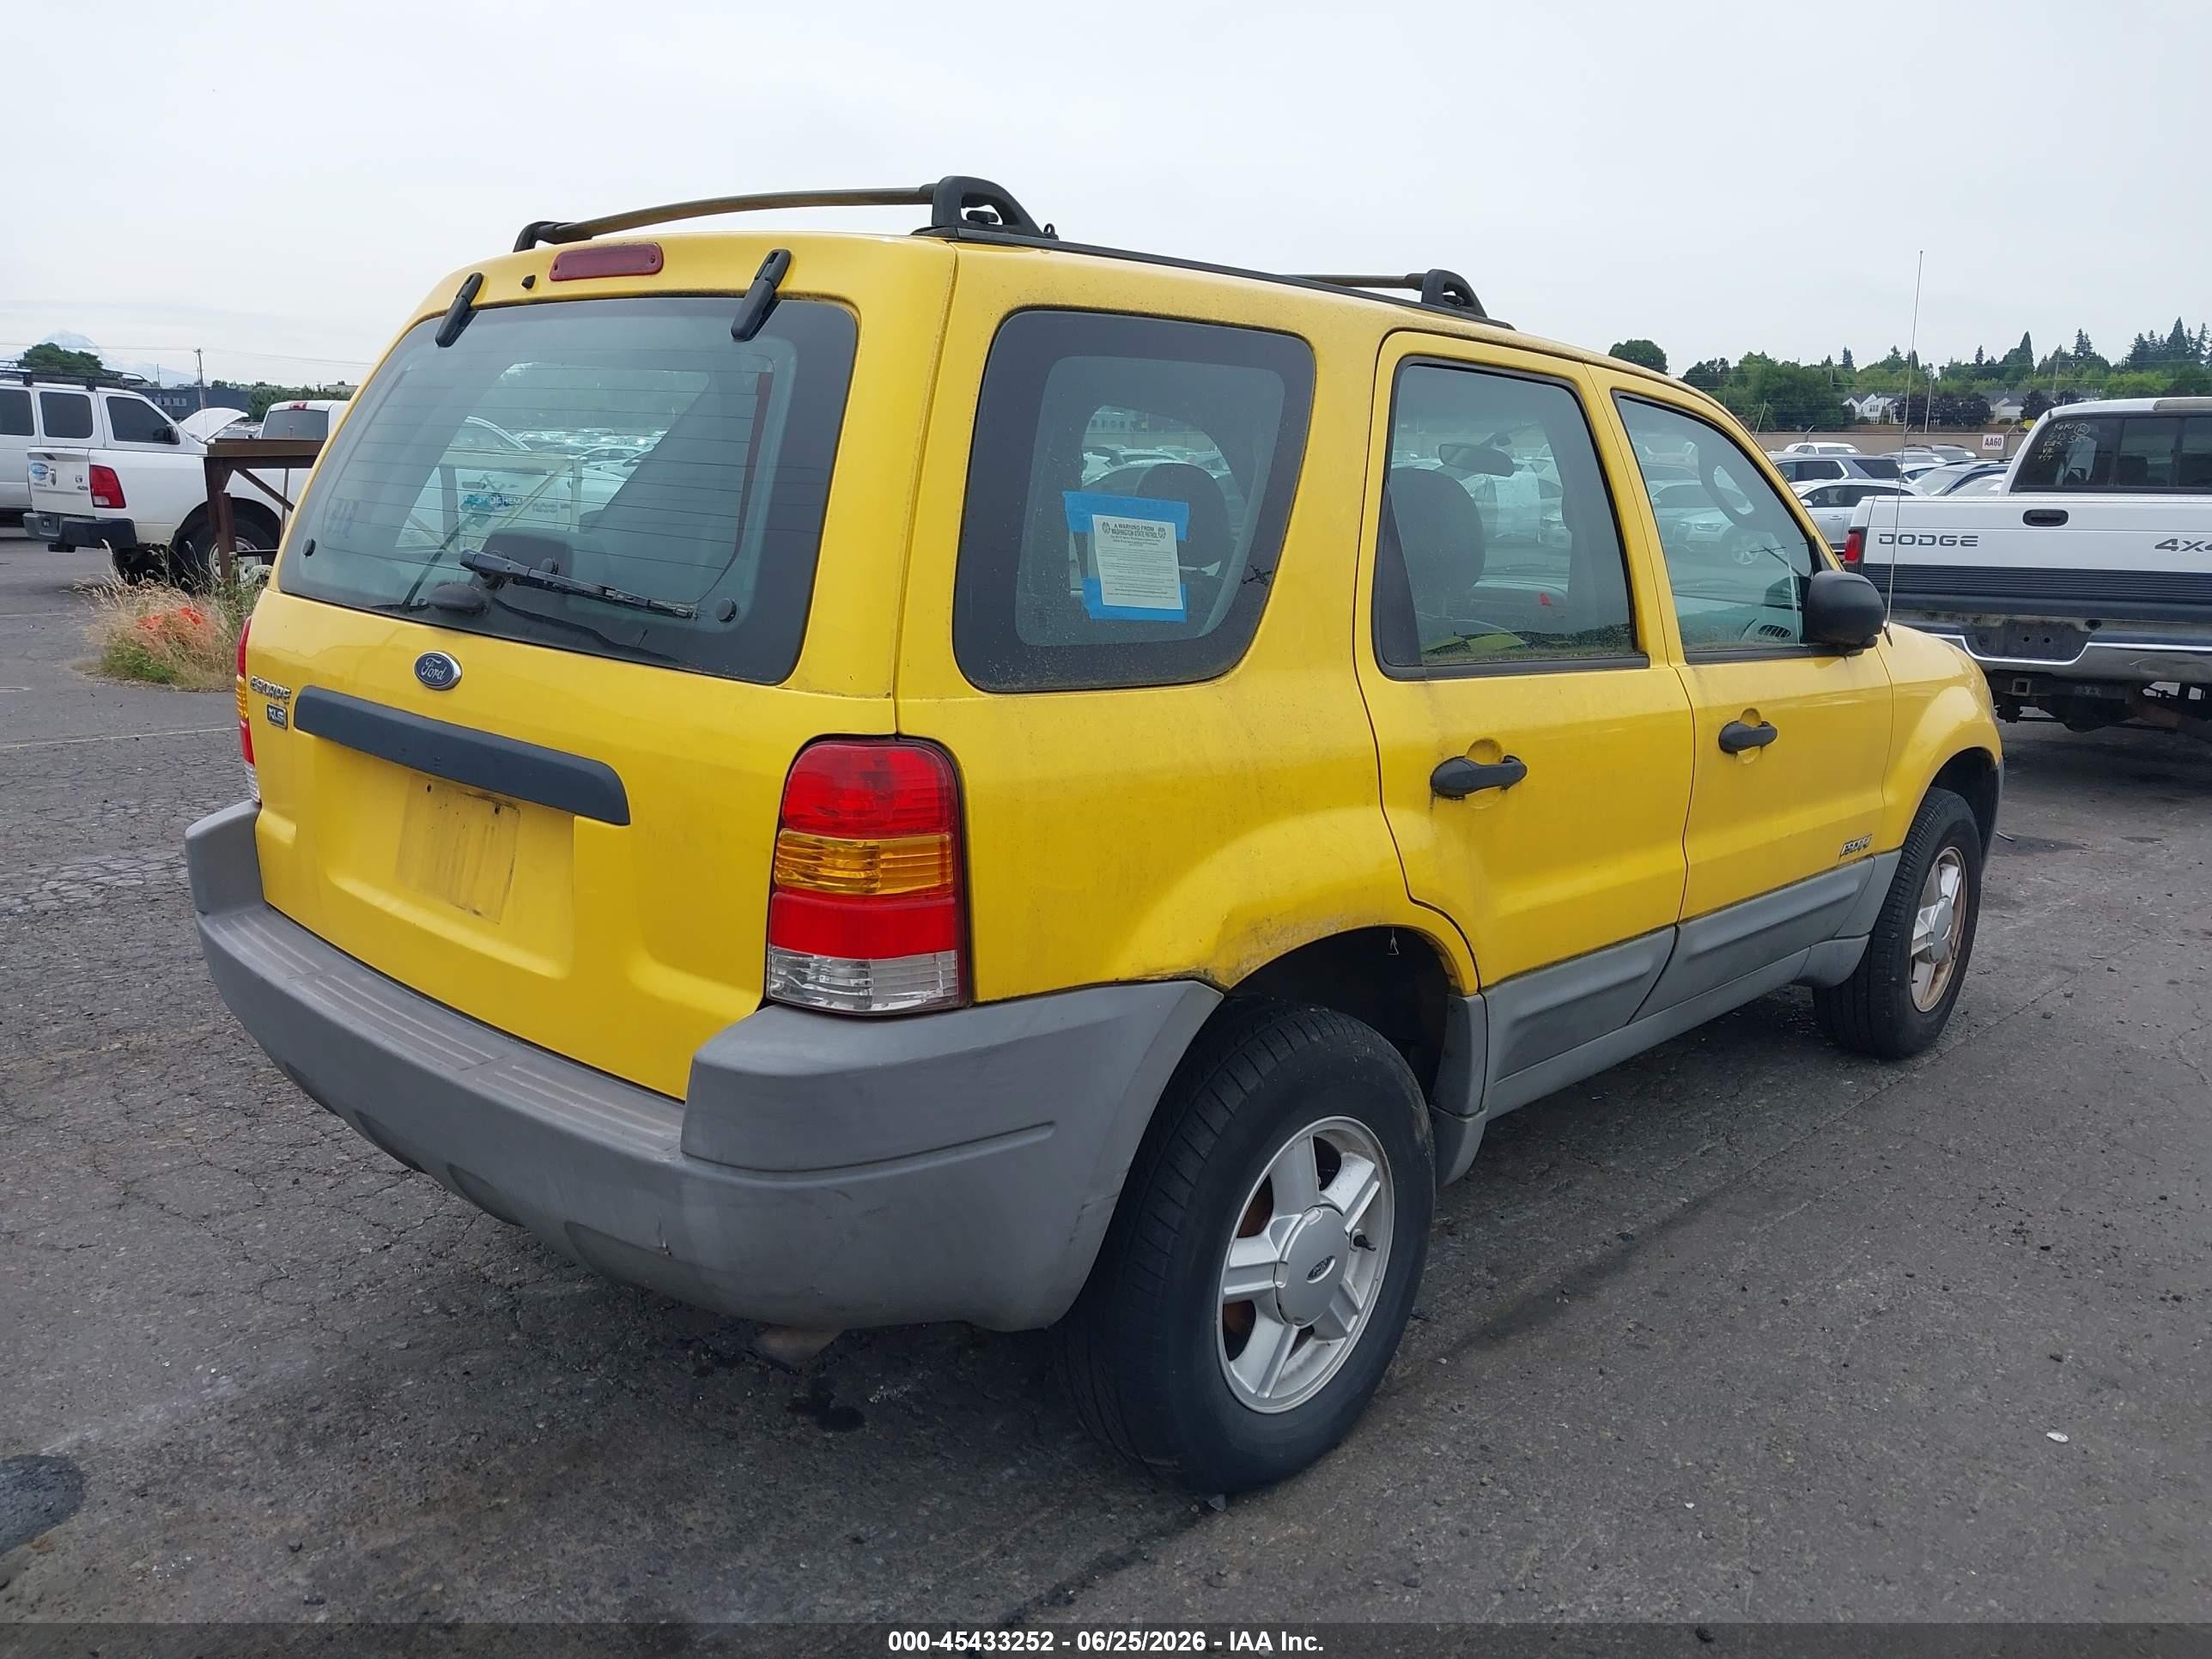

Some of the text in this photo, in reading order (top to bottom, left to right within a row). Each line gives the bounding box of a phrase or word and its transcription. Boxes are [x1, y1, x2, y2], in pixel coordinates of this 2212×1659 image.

[1984, 437, 2002, 447] AA60
[1878, 533, 1979, 547] DODGE
[421, 657, 447, 681] Ford
